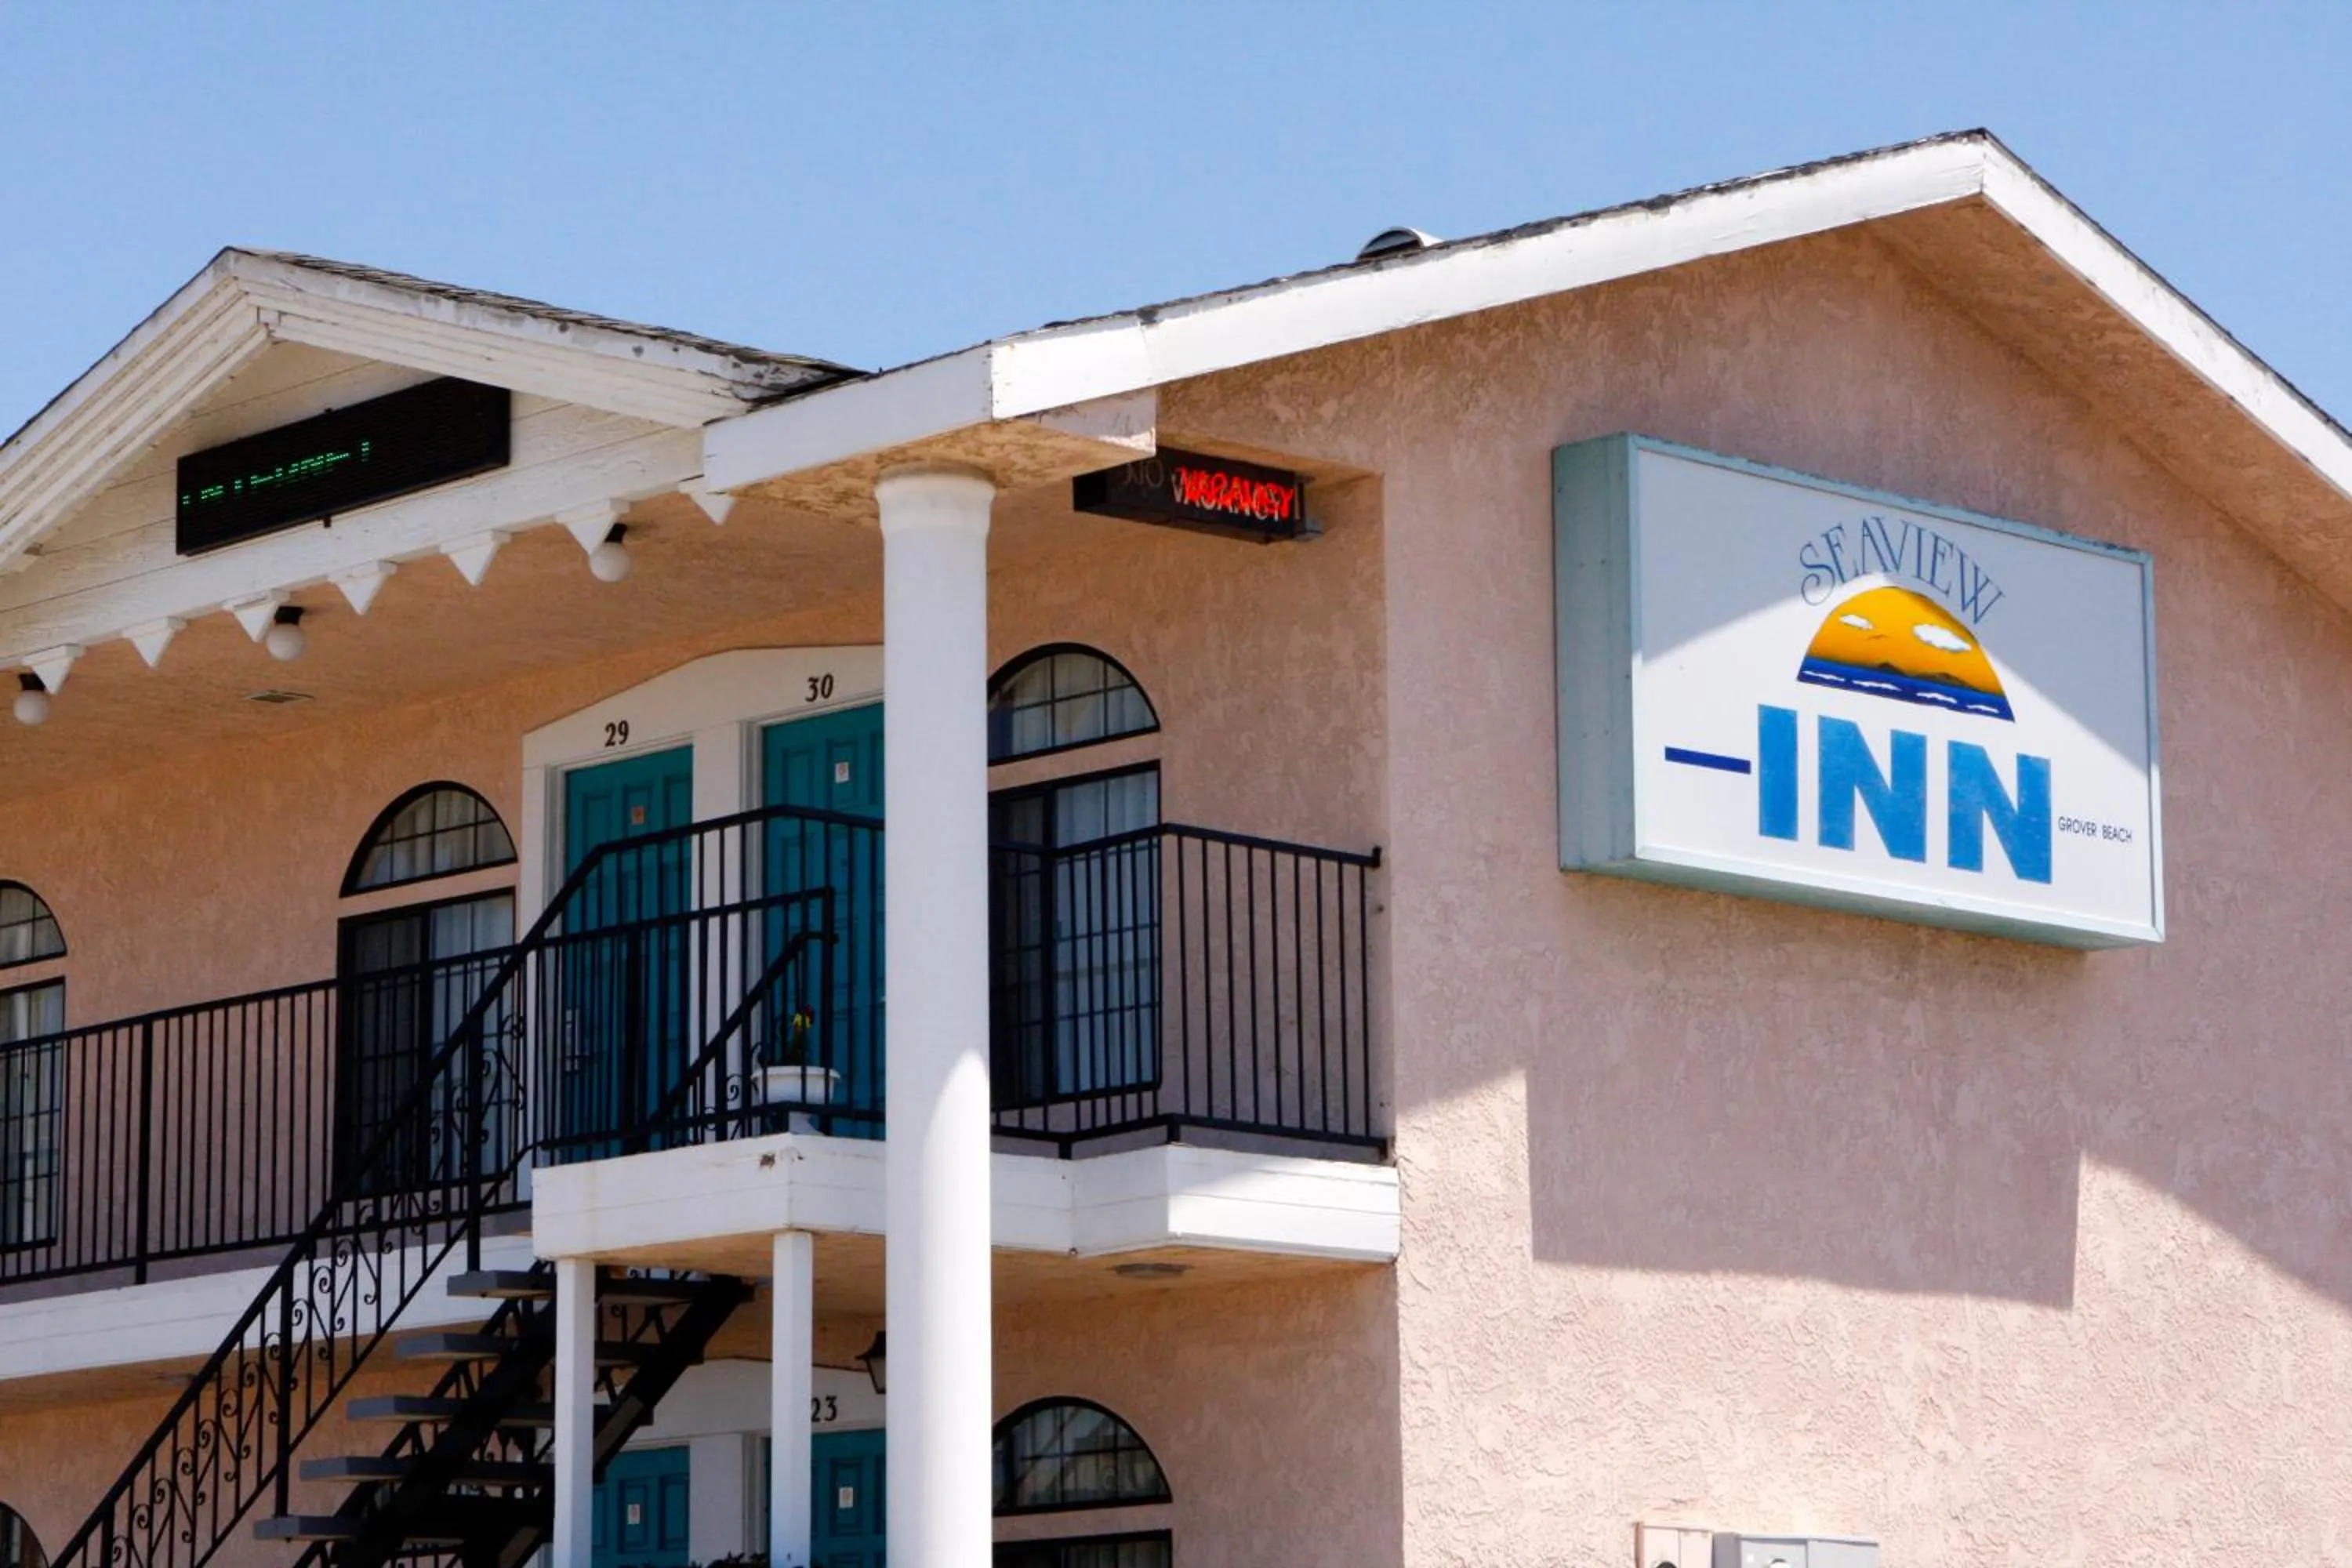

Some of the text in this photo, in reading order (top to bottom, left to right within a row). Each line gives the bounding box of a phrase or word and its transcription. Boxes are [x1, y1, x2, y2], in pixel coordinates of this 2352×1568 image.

[1171, 464, 1294, 522] VACANCY
[1799, 515, 2005, 626] SEAVIEW
[805, 673, 834, 702] 30
[604, 720, 630, 747] 29
[1757, 703, 2052, 885] INN
[2057, 815, 2132, 844] GROVER BEACH
[811, 1395, 838, 1423] 23
